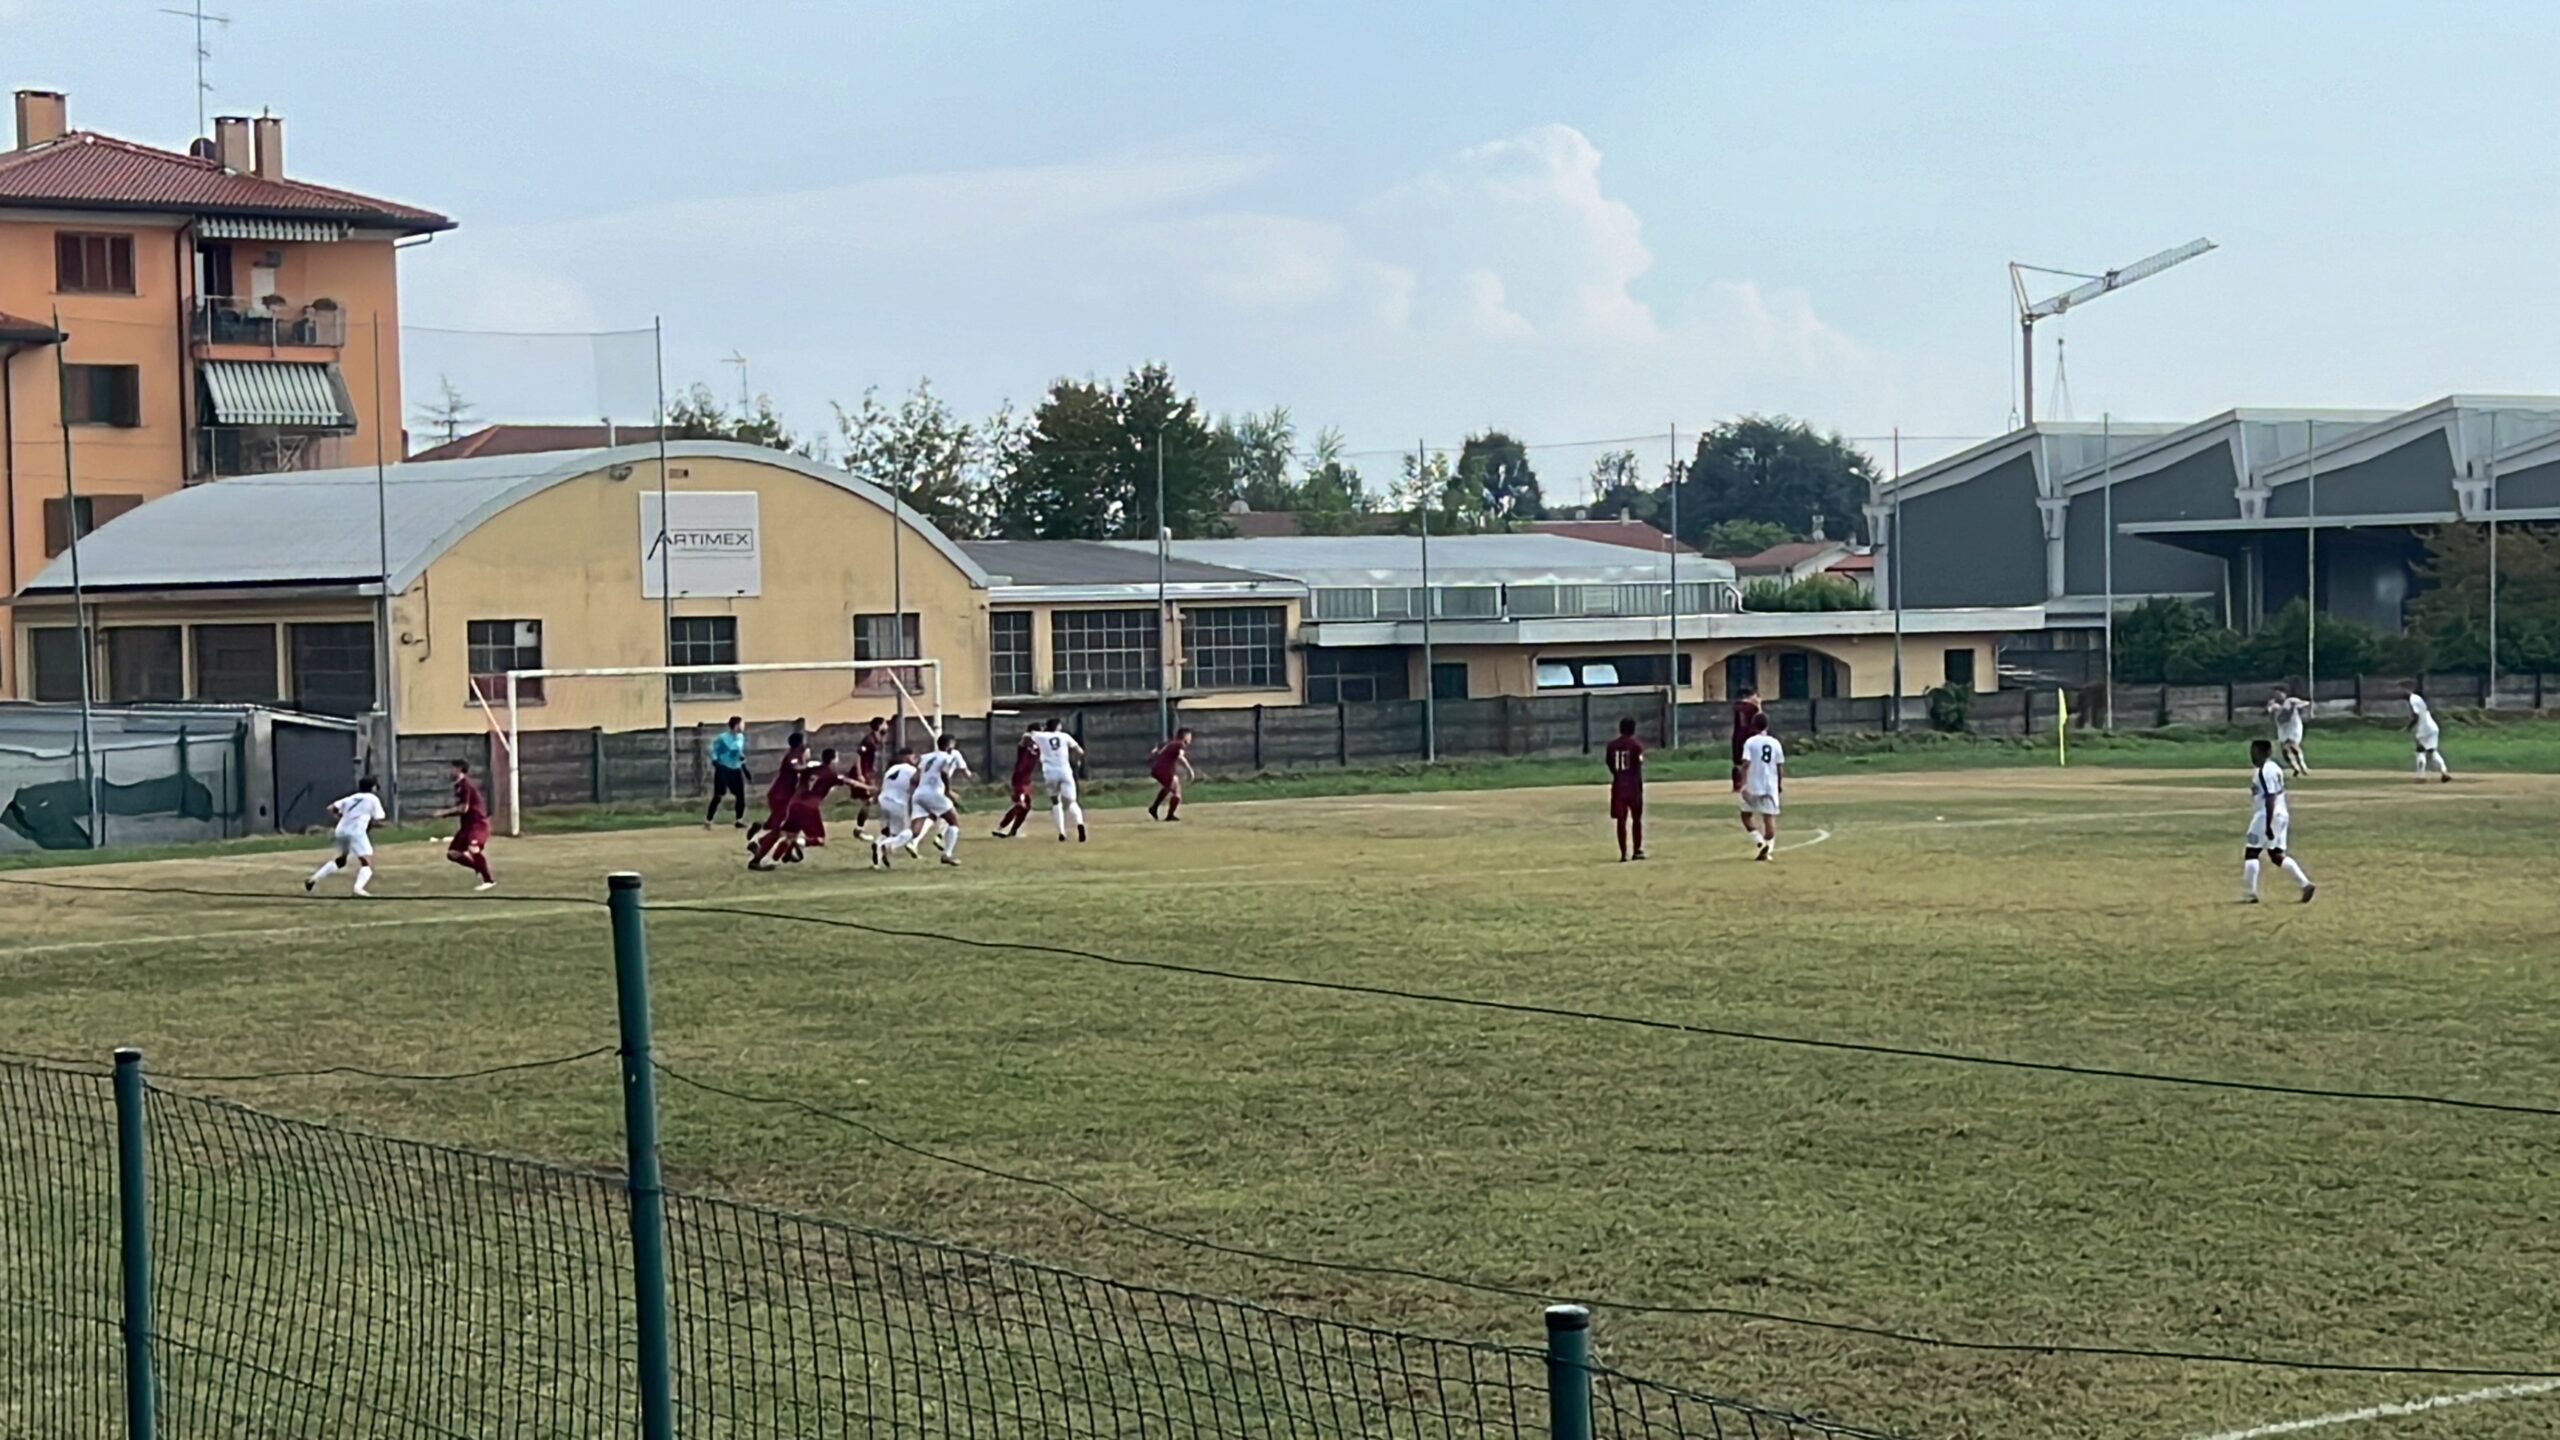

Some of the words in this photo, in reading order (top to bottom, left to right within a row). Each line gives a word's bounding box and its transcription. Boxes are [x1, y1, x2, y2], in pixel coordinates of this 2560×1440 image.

[647, 529, 749, 560] ARTIMEX
[1761, 744, 1772, 763] 8
[348, 798, 363, 813] 7
